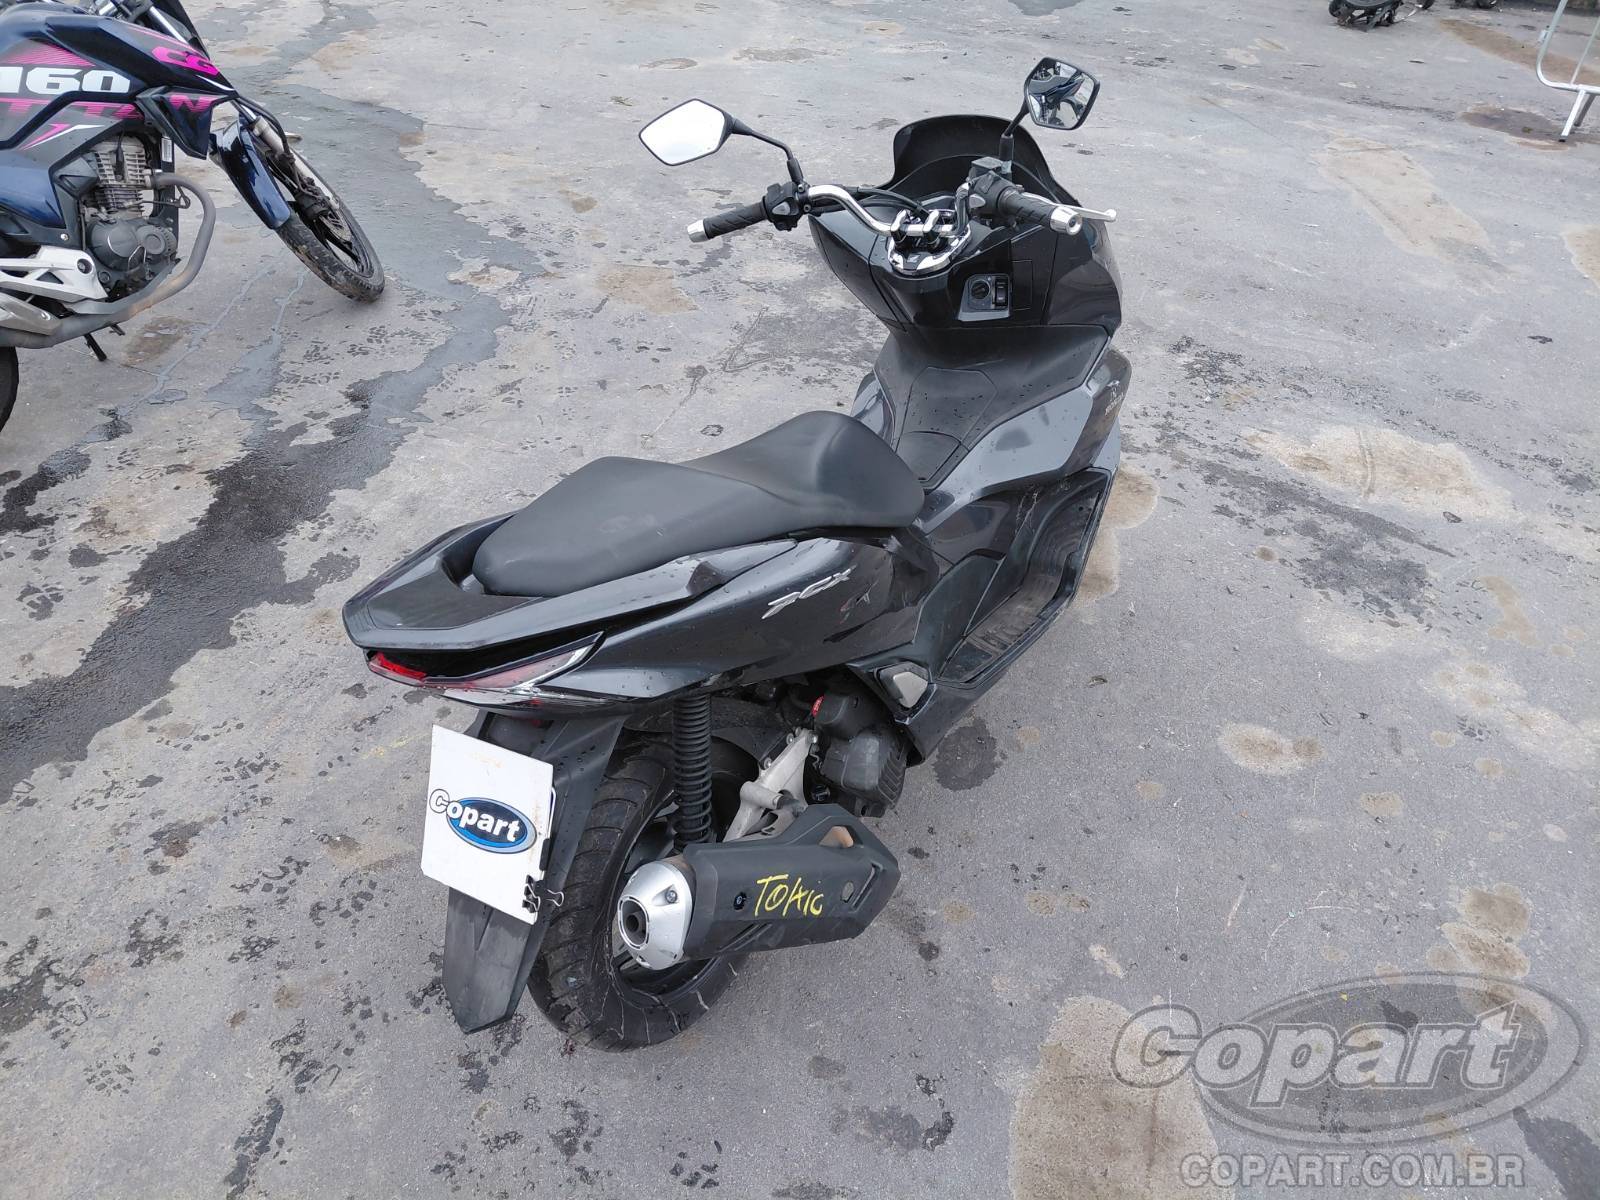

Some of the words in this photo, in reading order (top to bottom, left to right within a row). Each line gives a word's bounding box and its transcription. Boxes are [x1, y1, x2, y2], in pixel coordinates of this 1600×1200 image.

[151, 46, 220, 76] CG
[0, 66, 131, 95] 160
[429, 788, 520, 843] Copart
